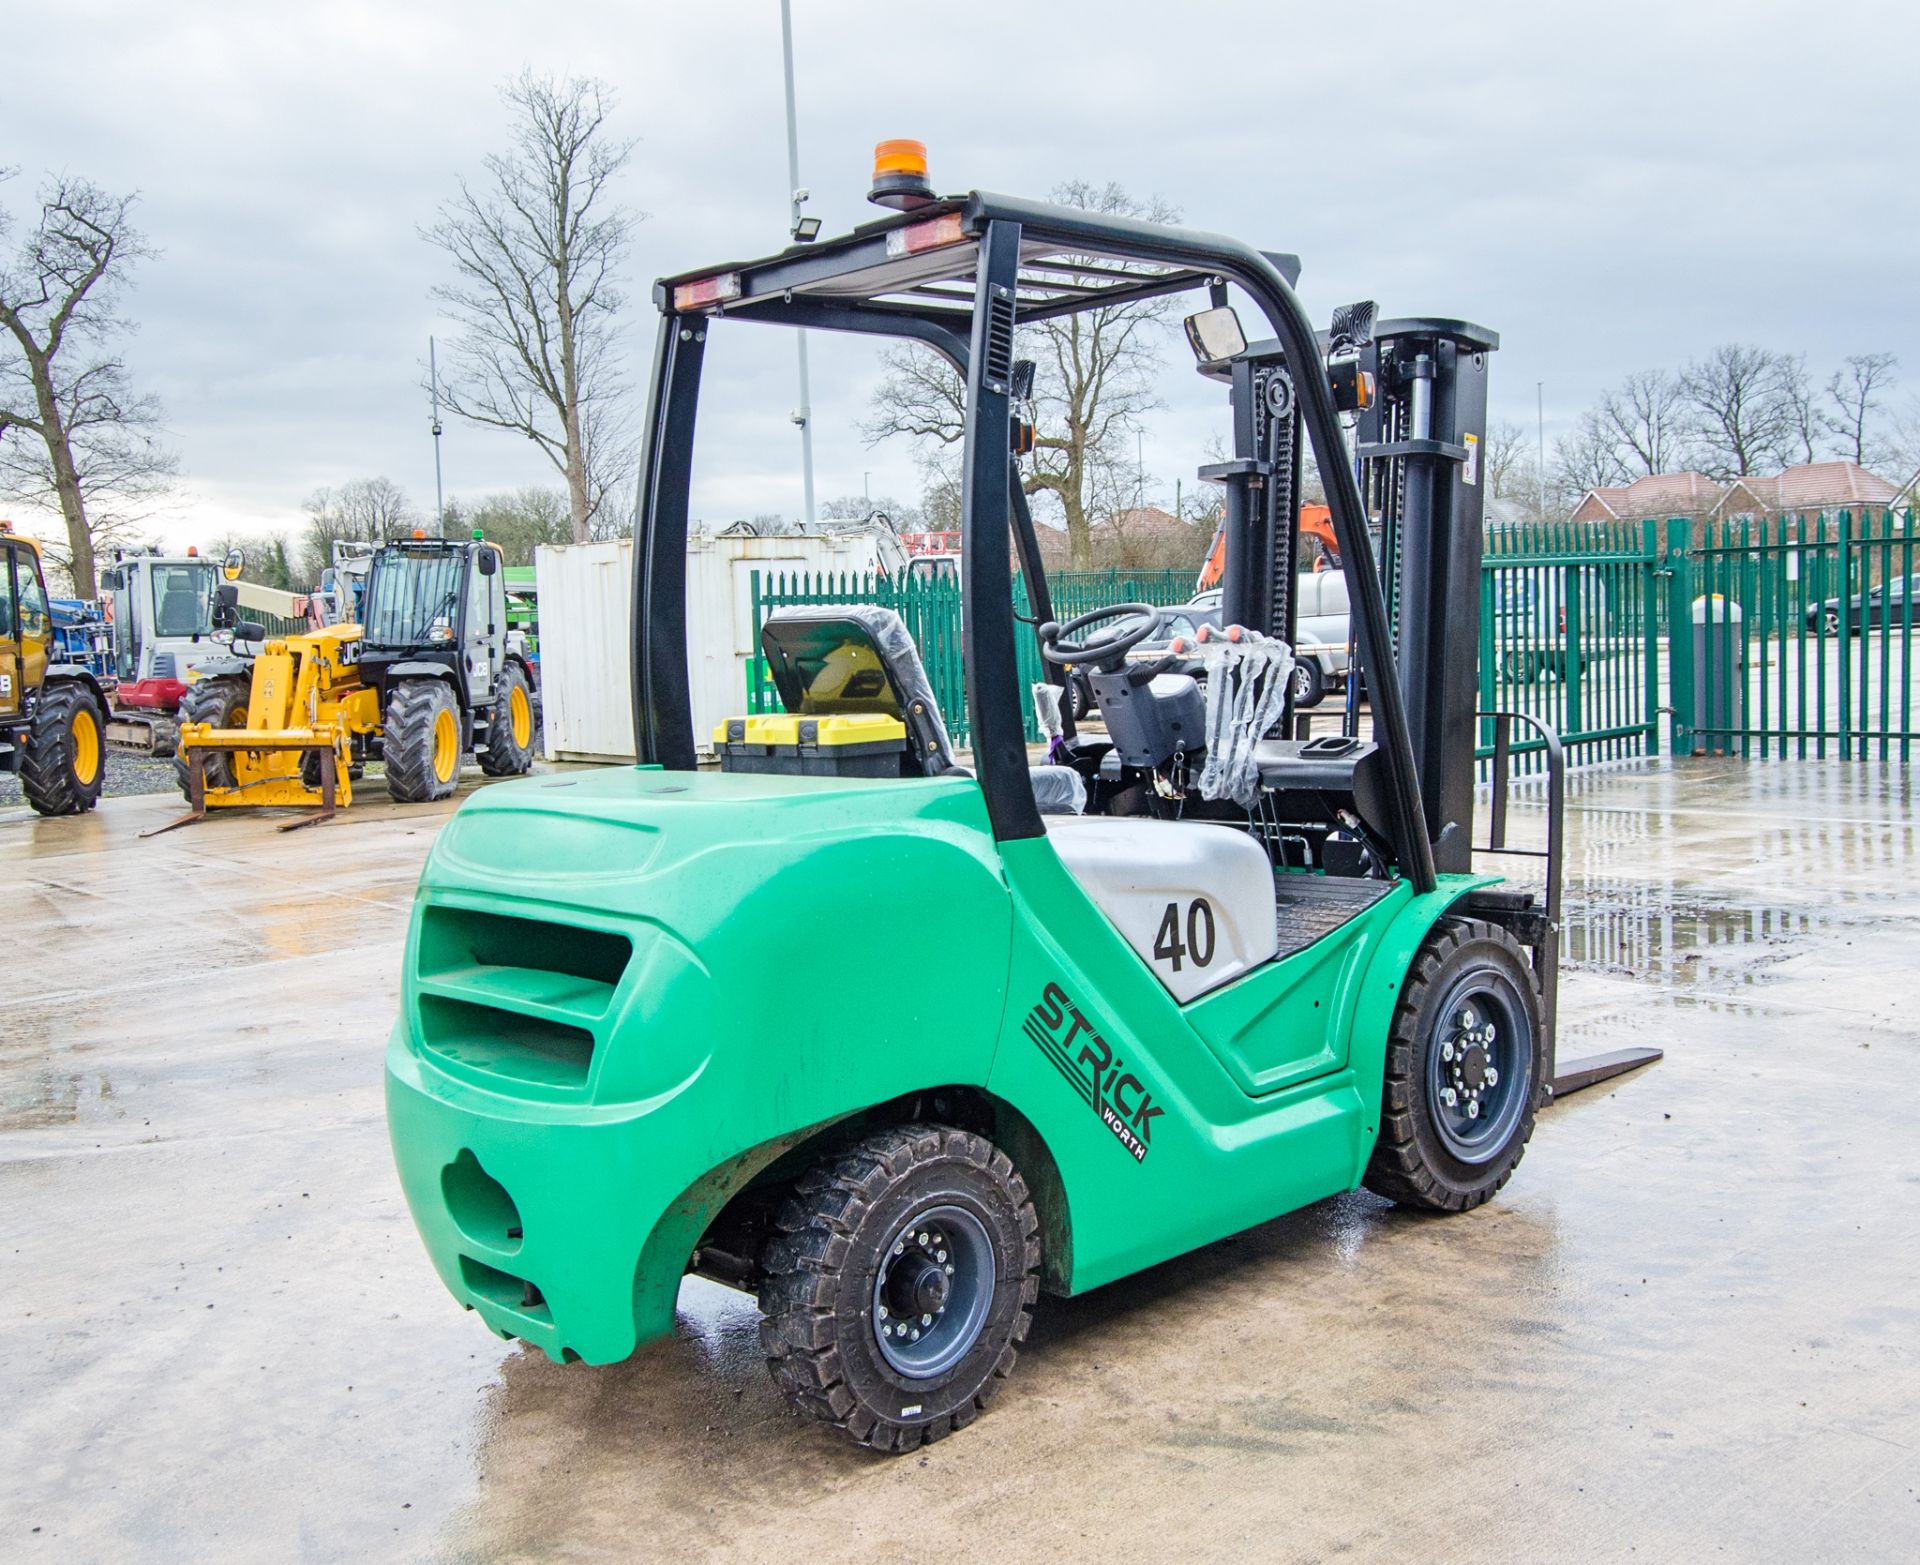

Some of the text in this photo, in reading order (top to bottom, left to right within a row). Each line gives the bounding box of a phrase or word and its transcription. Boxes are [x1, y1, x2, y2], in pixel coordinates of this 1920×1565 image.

[343, 641, 363, 665] JC
[473, 661, 488, 677] JCB
[1153, 898, 1216, 972] 40
[1103, 1107, 1146, 1160] WORTH
